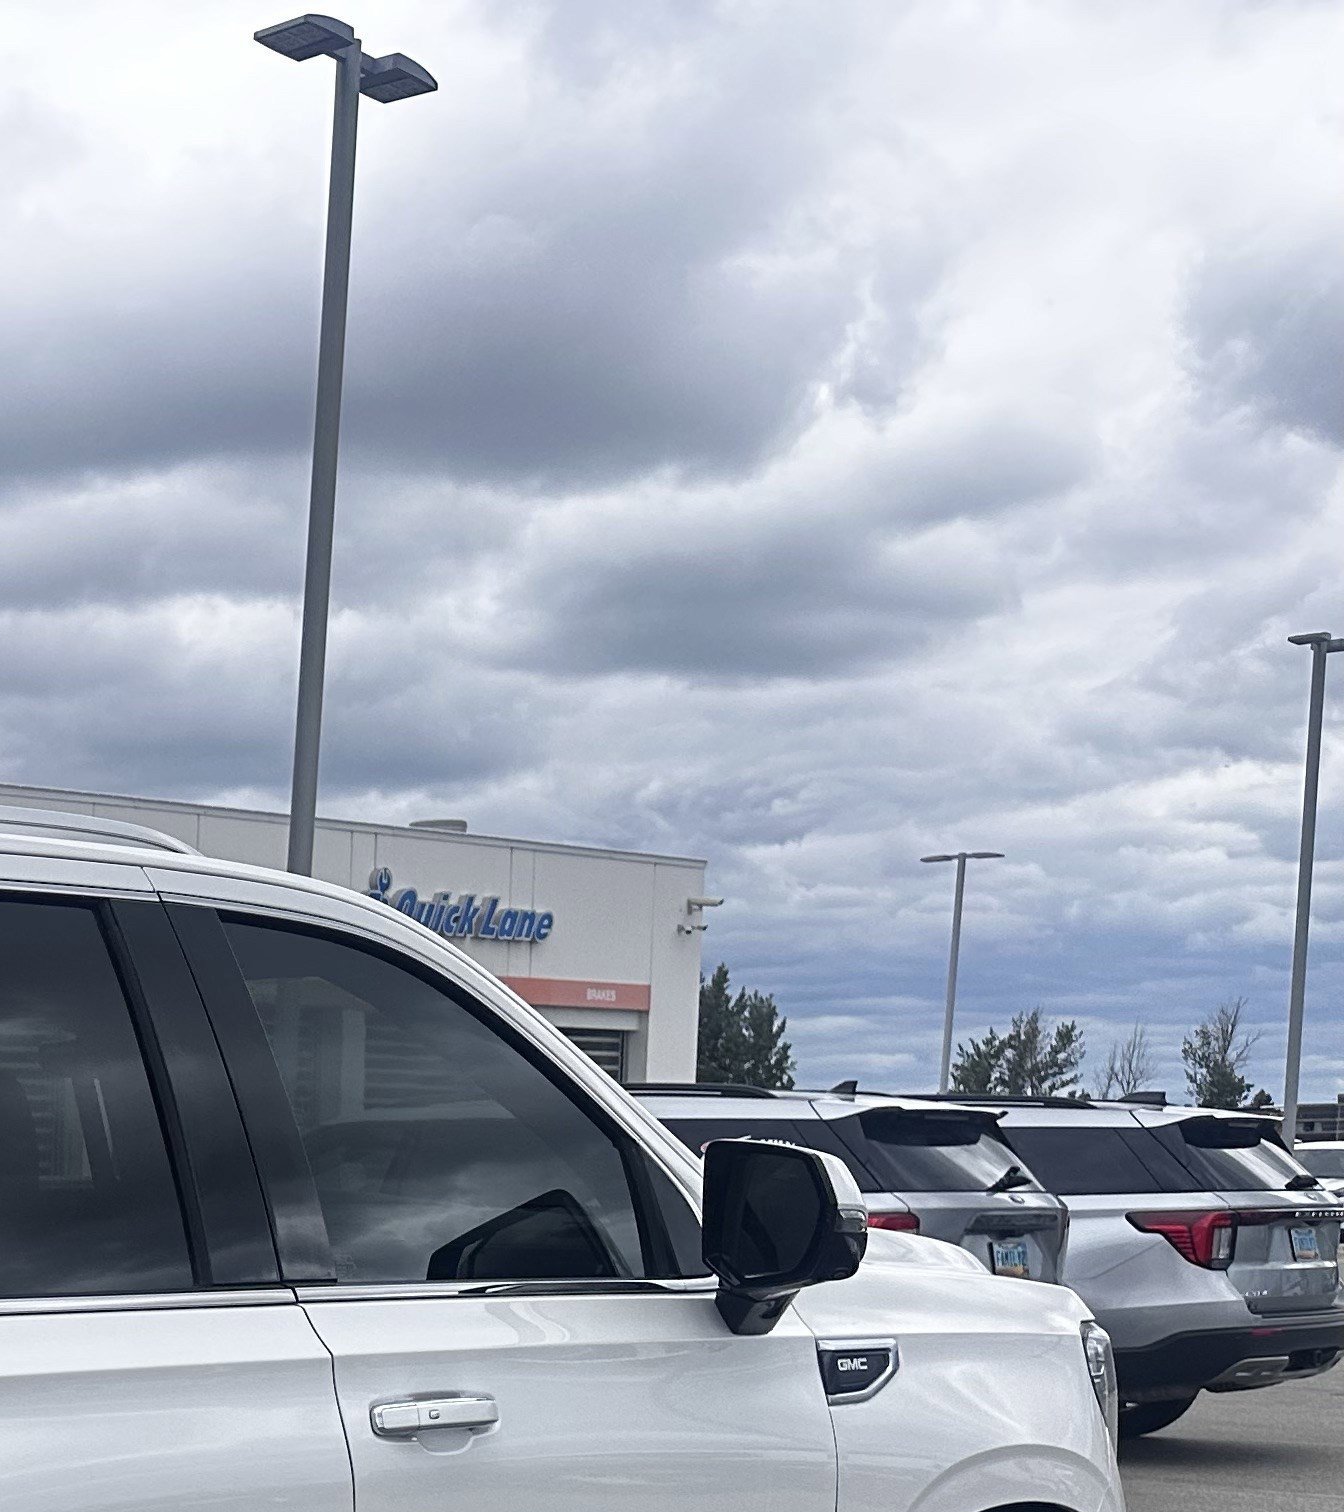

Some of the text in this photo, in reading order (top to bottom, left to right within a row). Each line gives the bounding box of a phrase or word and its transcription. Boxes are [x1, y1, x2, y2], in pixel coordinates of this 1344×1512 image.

[392, 887, 553, 941] Quick Lane
[837, 1357, 868, 1371] GMC
